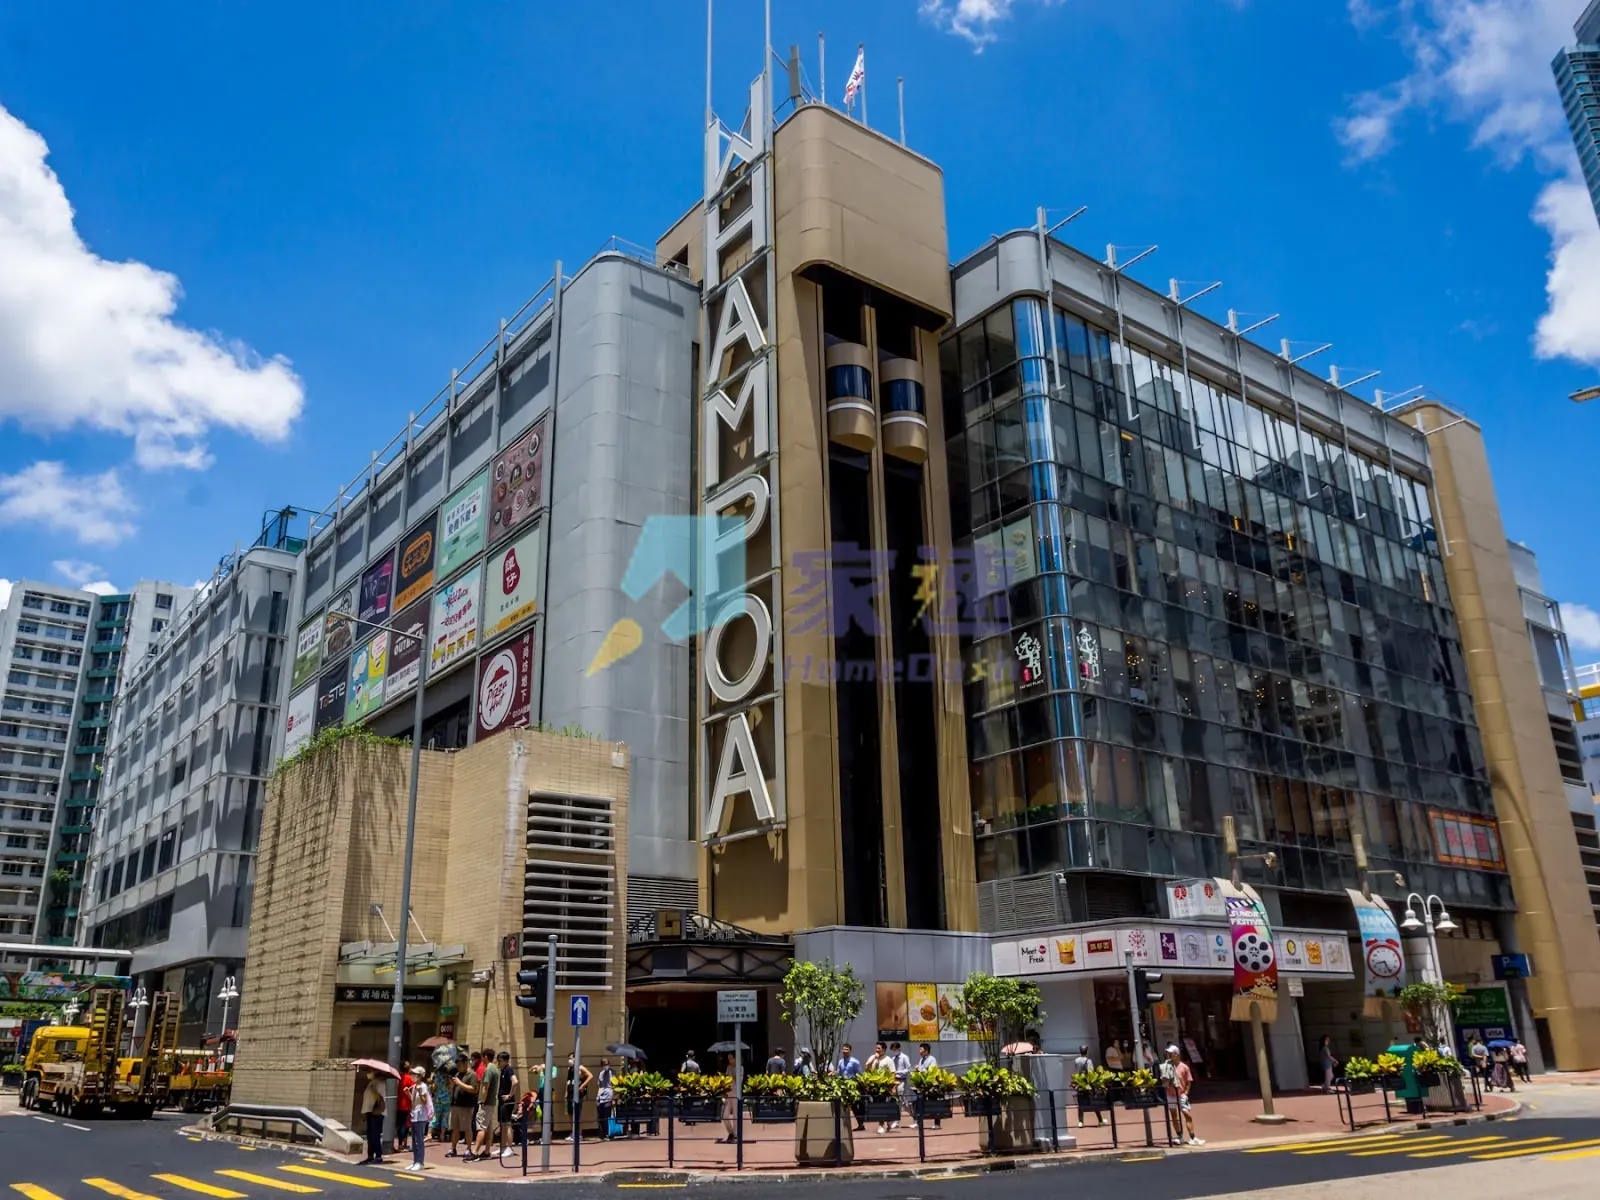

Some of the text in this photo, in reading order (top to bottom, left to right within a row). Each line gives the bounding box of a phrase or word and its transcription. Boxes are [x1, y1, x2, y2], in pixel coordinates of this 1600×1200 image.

[704, 72, 768, 836] WHAMPOA
[485, 679, 509, 709] Pizza
[488, 691, 507, 719] Hut
[1021, 947, 1038, 956] Meet
[1028, 955, 1045, 964] Fresh
[361, 989, 390, 999] 黃埔站
